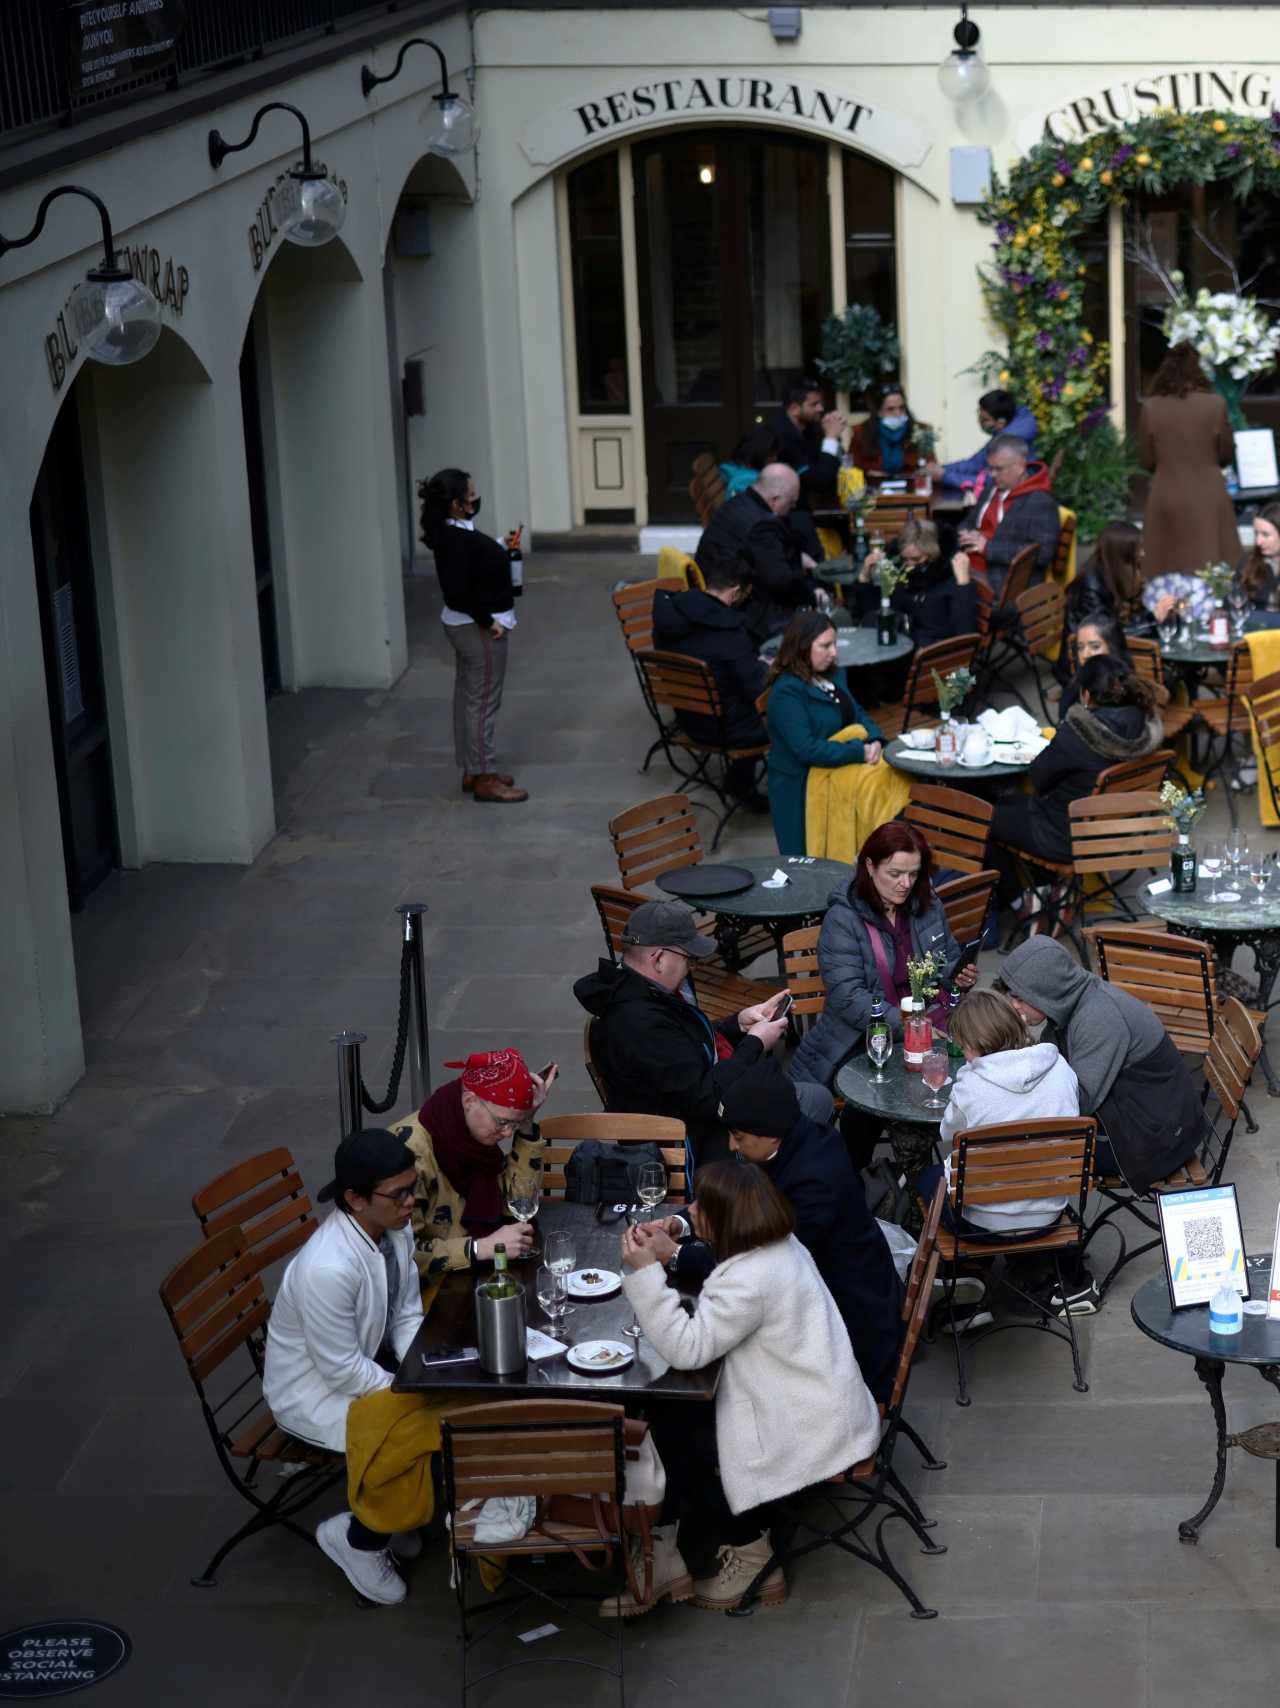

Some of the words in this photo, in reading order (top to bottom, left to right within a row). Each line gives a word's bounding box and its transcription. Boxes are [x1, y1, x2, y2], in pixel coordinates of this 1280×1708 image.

[573, 77, 874, 136] RESTAURANT
[1044, 71, 1272, 146] CRUSTING
[22, 1638, 94, 1648] PLEASE
[8, 1648, 96, 1659] OBSERVE
[10, 1660, 78, 1670] SOCIAL
